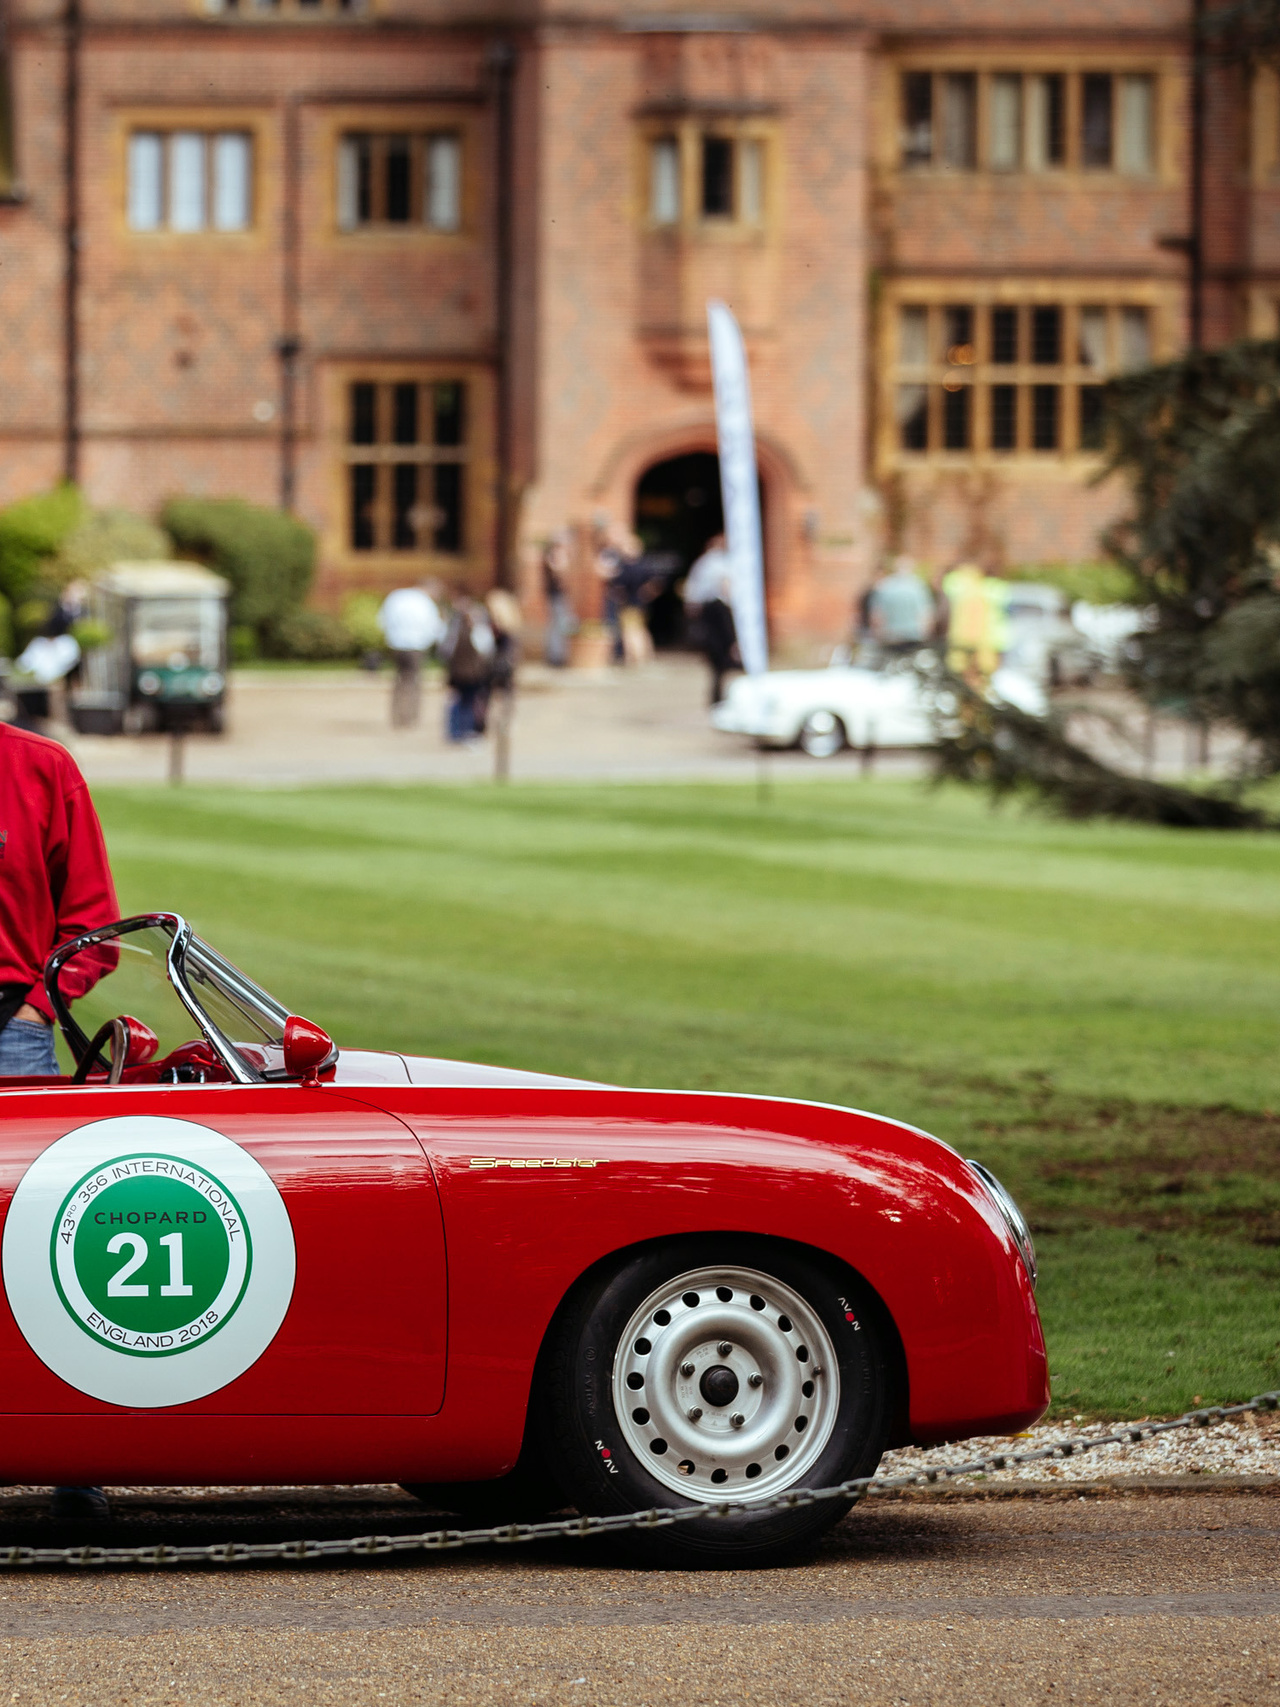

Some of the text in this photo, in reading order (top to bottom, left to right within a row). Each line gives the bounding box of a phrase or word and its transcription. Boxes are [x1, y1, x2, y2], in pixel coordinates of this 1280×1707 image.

[78, 1174, 108, 1204] 356
[111, 1160, 241, 1242] INTERNATIONAL
[94, 1211, 208, 1225] CHOPARD
[106, 1232, 194, 1298] 21
[86, 1311, 219, 1348] ENGLAND 2018
[837, 1297, 861, 1331] AVON
[594, 1440, 619, 1474] AVON
